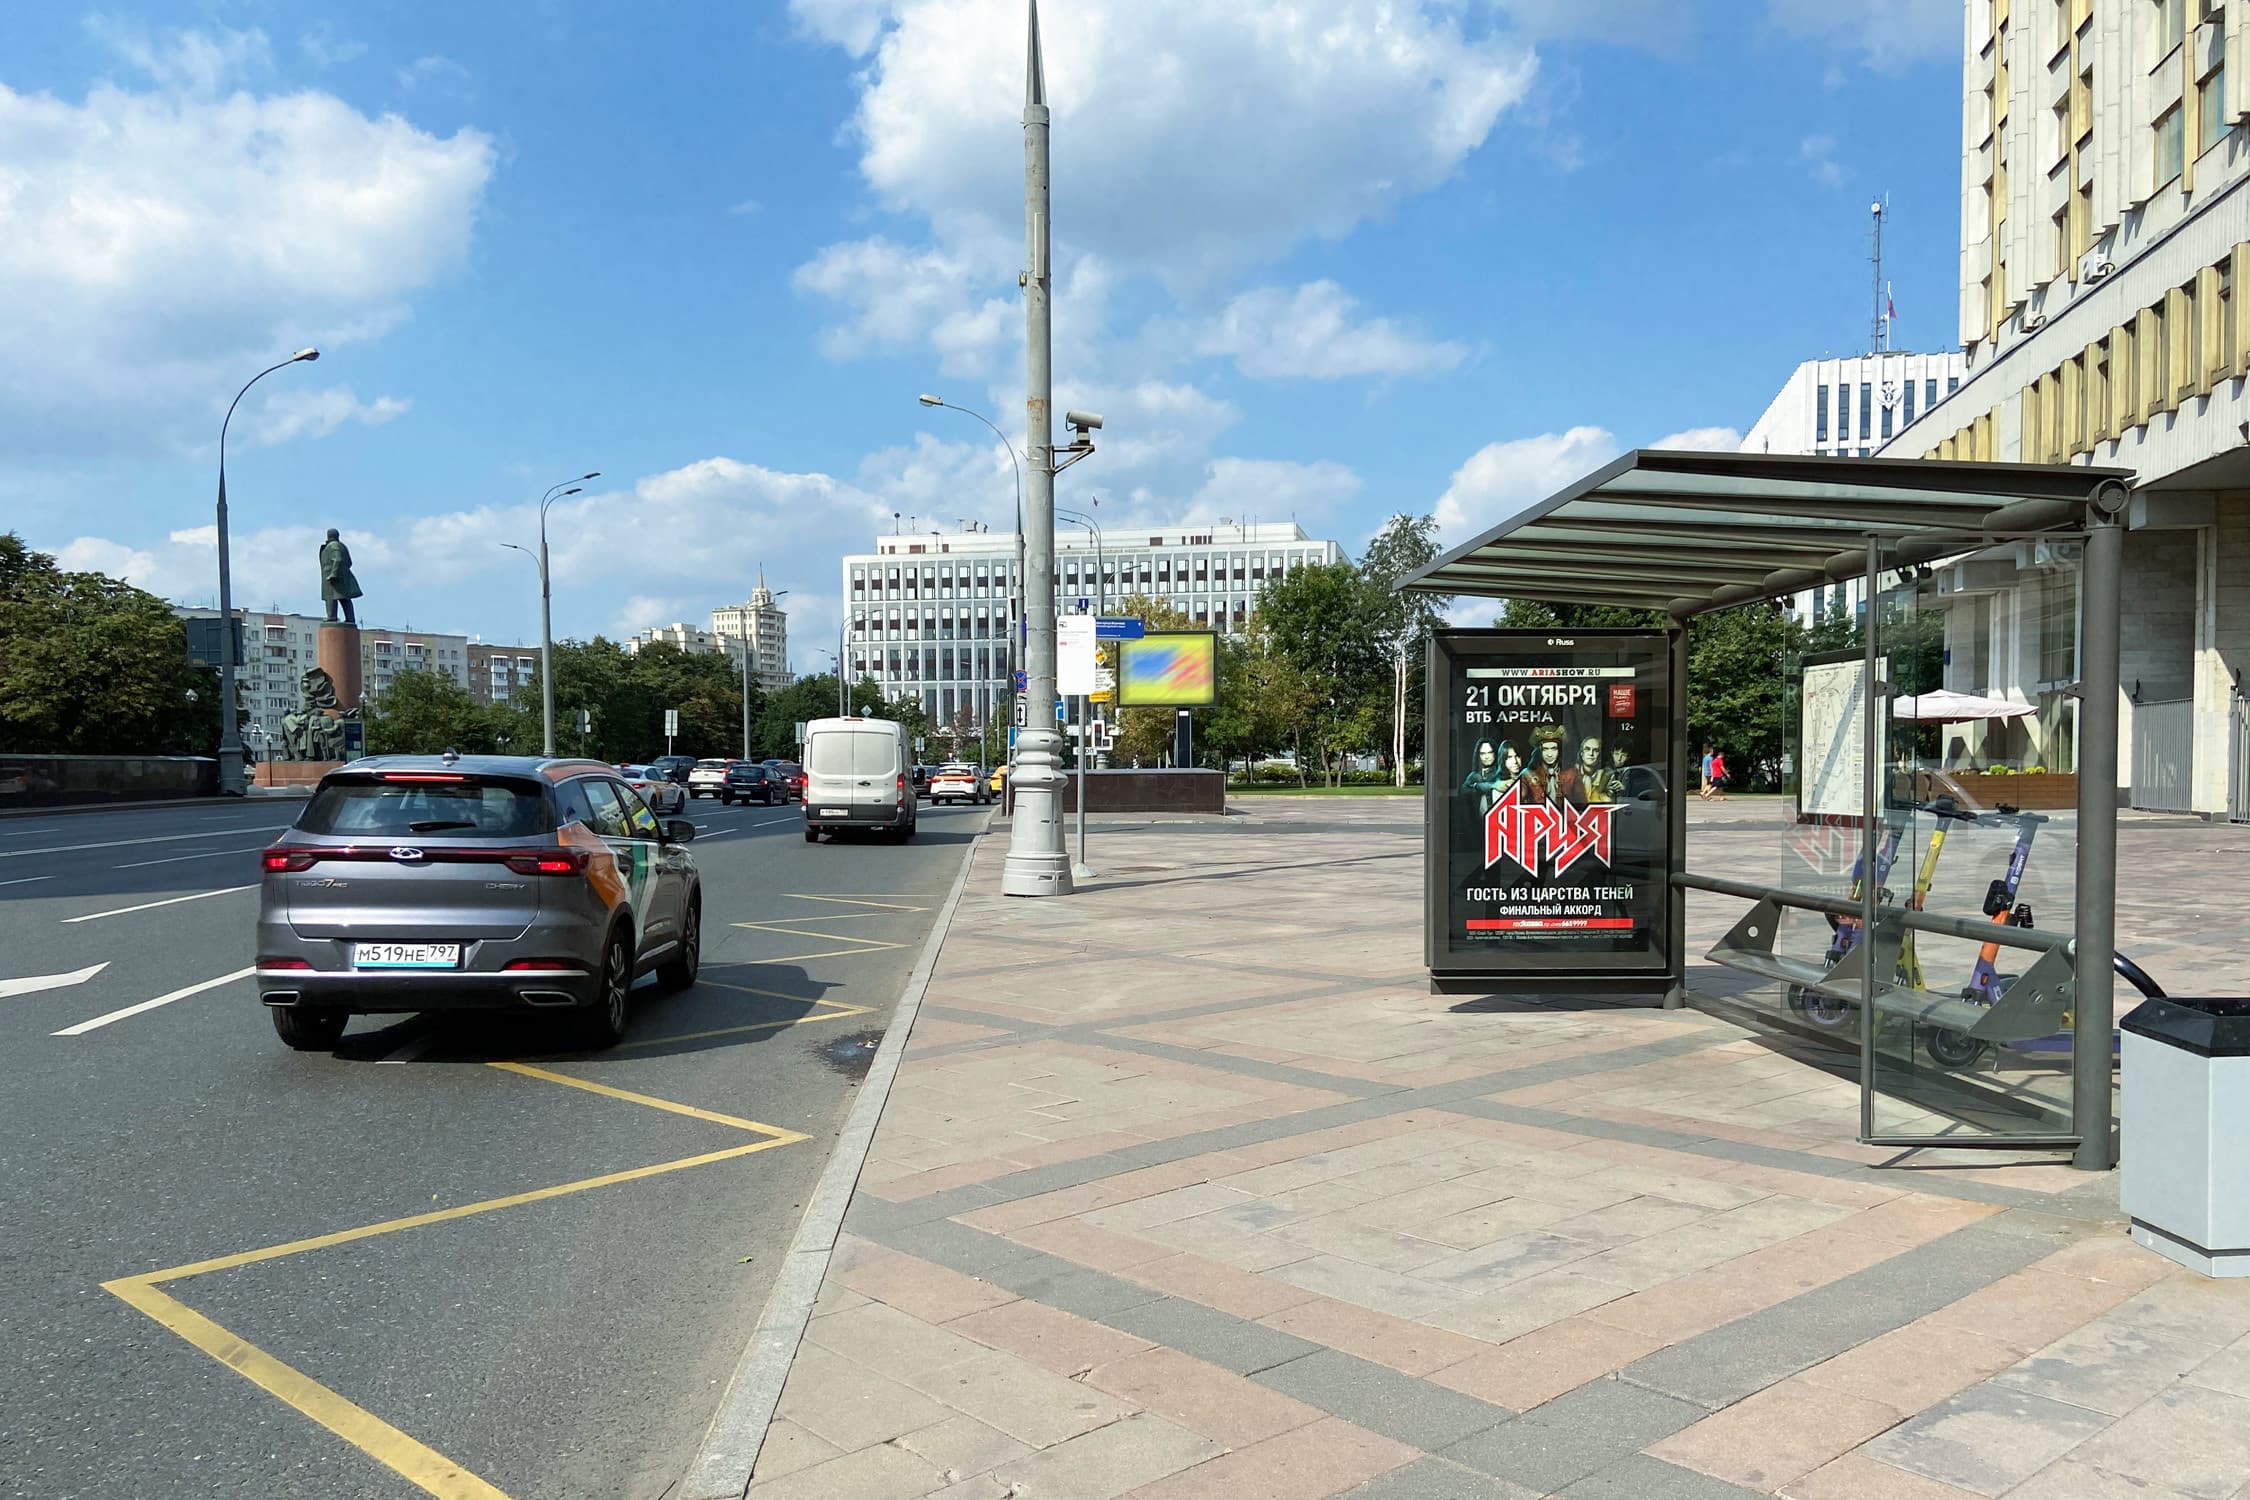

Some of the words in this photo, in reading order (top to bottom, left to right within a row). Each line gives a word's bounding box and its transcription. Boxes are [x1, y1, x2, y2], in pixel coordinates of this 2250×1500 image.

[1555, 638, 1574, 646] Russ
[1466, 685, 1489, 707] 21
[1498, 684, 1597, 706] ОКТЯБРЯ
[1466, 711, 1492, 723] ВТБ
[1496, 710, 1554, 723] АРЕНА
[1621, 722, 1634, 731] 12+
[1485, 779, 1632, 879] АРИЯ
[1466, 887, 1507, 901] ГОСТЬ
[1511, 887, 1528, 900] ИЗ
[1532, 887, 1590, 903] ЦАРСТВА
[1593, 884, 1633, 900] ТЕНЕЙ
[1500, 903, 1562, 916] ФИНАЛЬНЫЙ
[1564, 904, 1602, 916] АККОРД
[430, 945, 455, 959] 797
